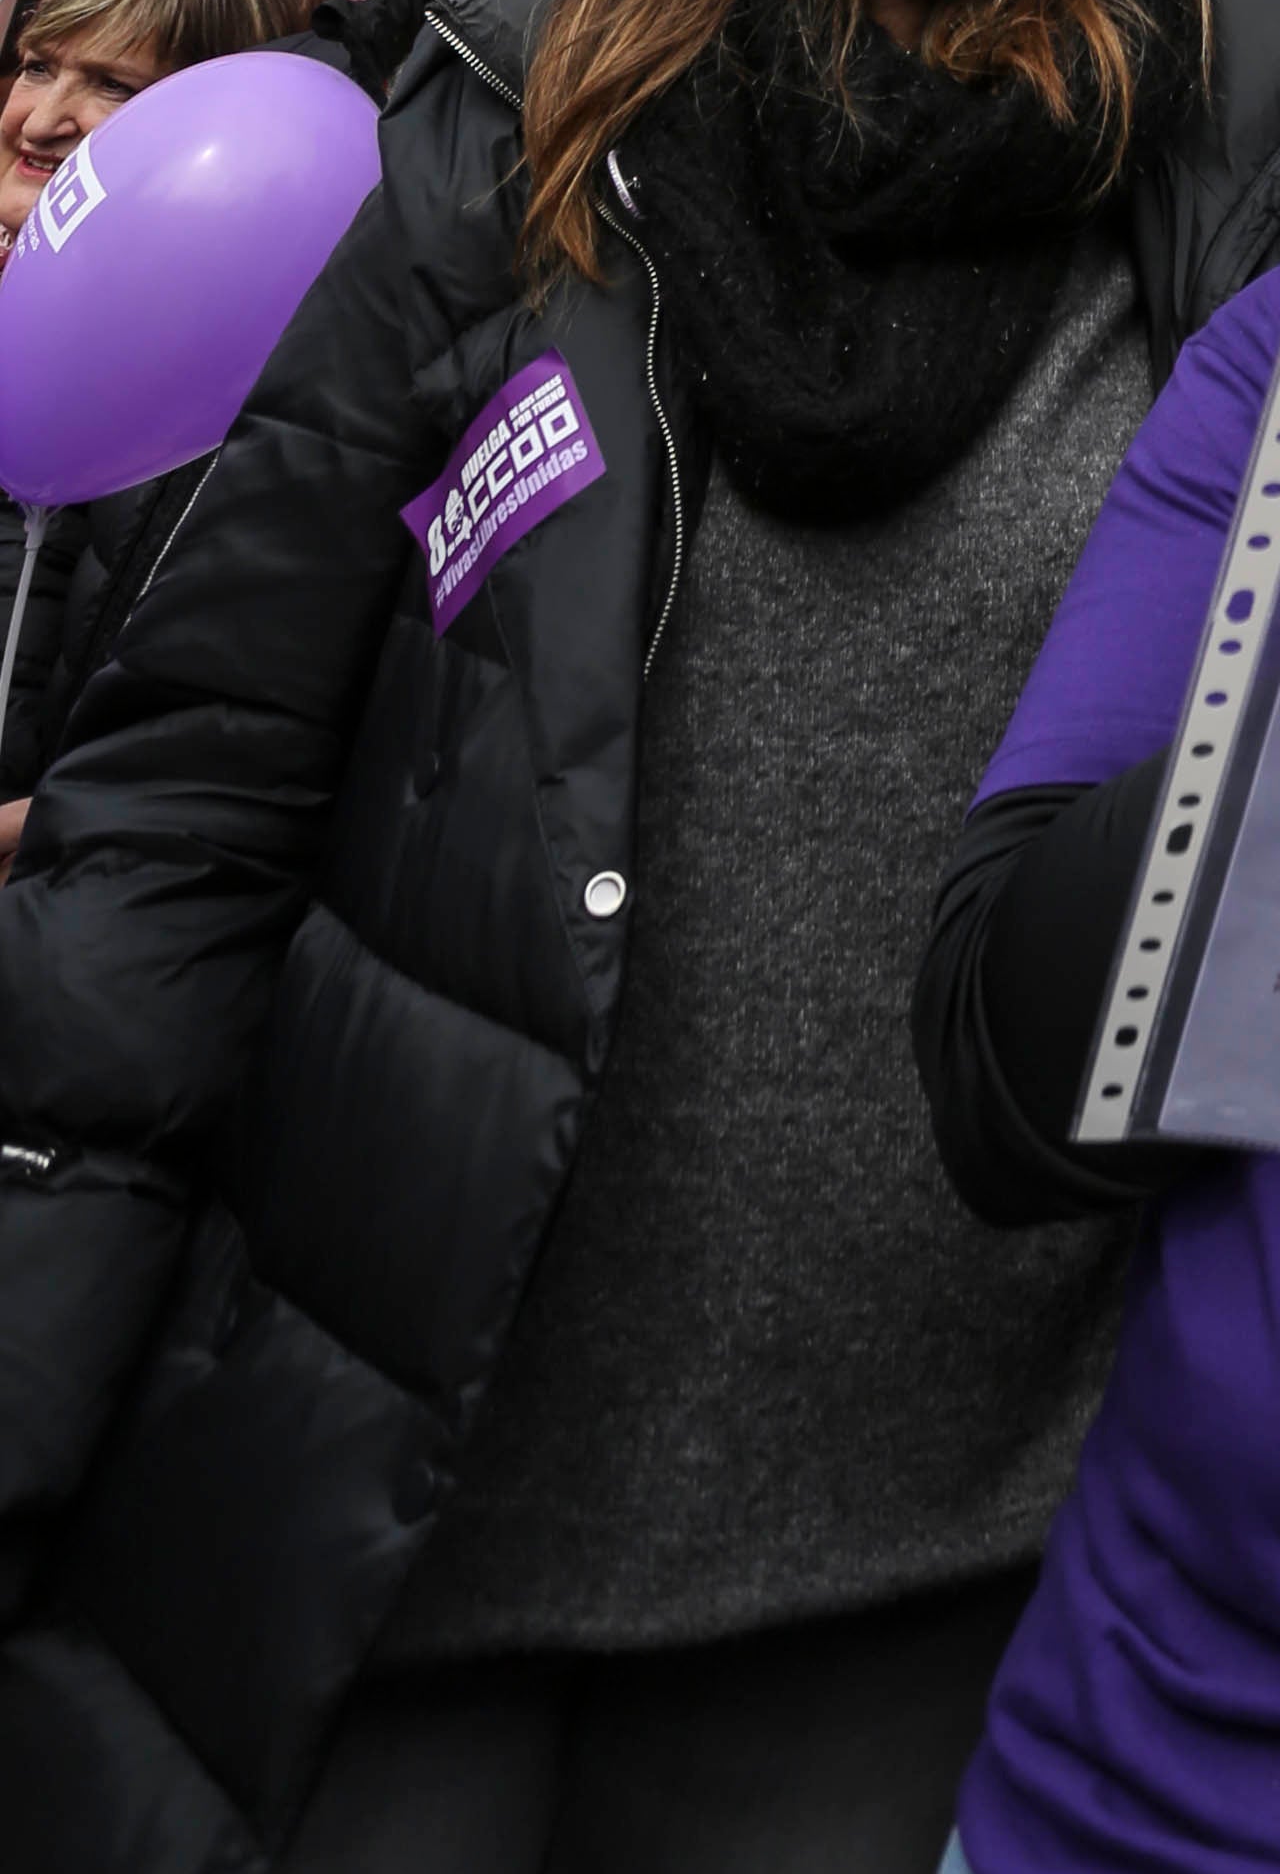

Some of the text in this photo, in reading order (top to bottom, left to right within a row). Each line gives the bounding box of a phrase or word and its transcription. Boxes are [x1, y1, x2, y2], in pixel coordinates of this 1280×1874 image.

[426, 399, 581, 578] 8 CCOO
[460, 417, 512, 491] HUELGA
[530, 384, 567, 416] TURNO
[434, 438, 590, 611] #VivasLibresUnidas
